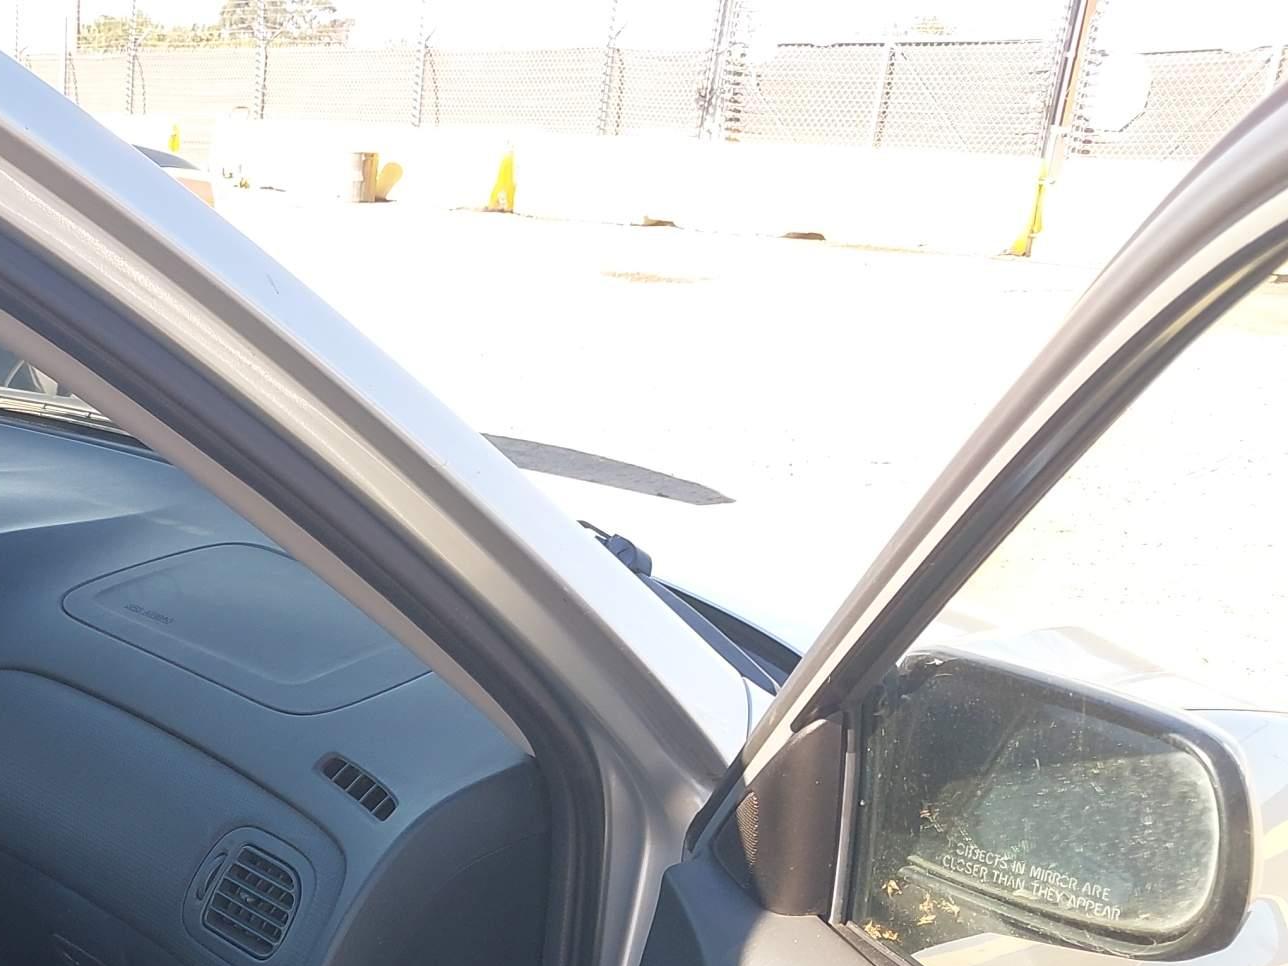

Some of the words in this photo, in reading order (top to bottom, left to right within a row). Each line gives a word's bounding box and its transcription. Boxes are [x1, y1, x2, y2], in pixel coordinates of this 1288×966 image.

[942, 854, 988, 878] CLOSER
[992, 870, 1026, 890] THAN
[1031, 882, 1062, 902] THEY
[1066, 894, 1121, 921] APPEAR
[956, 842, 1008, 869] OBJECTS
[1012, 860, 1026, 875] IN
[1029, 865, 1078, 891] MIRROR
[1081, 882, 1112, 901] ARE
